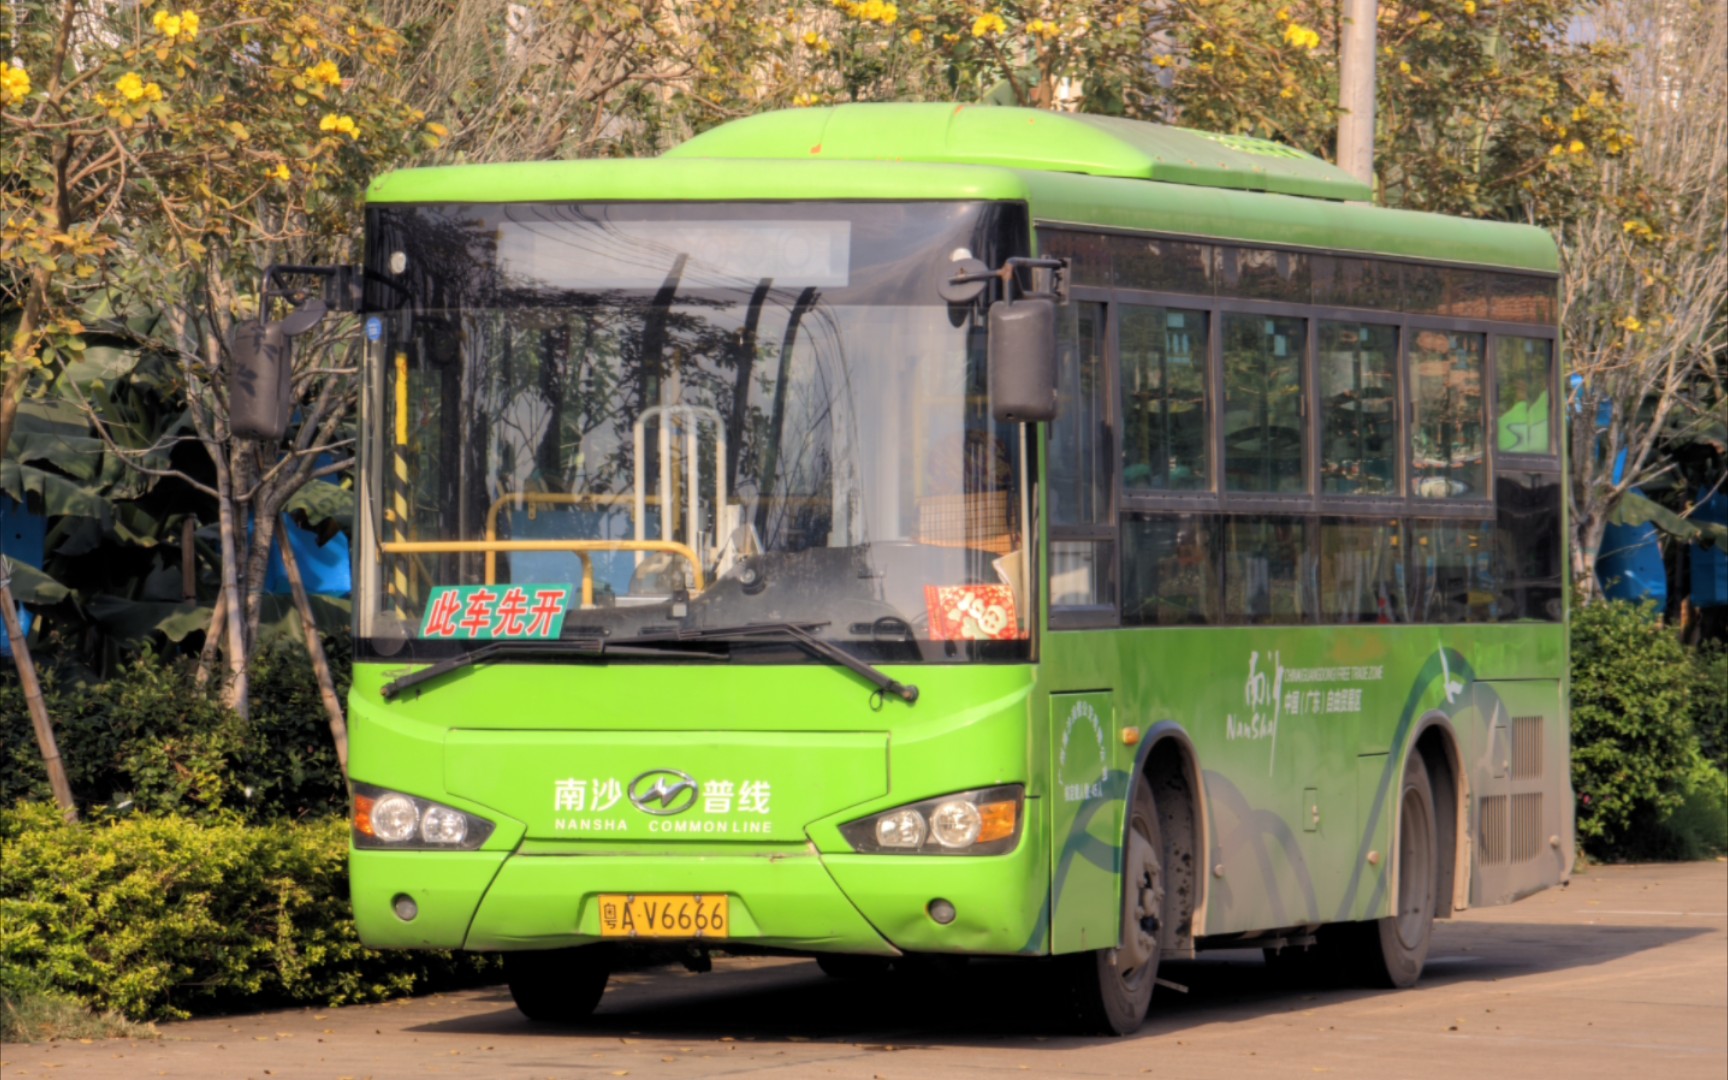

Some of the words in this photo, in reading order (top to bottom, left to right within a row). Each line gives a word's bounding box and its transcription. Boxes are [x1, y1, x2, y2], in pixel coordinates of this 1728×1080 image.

[424, 588, 566, 637] 此车先开
[554, 777, 622, 813] 南沙
[703, 779, 771, 814] 普线
[555, 819, 628, 831] NANSHA
[649, 820, 728, 833] COMMON
[733, 822, 772, 833] LINE
